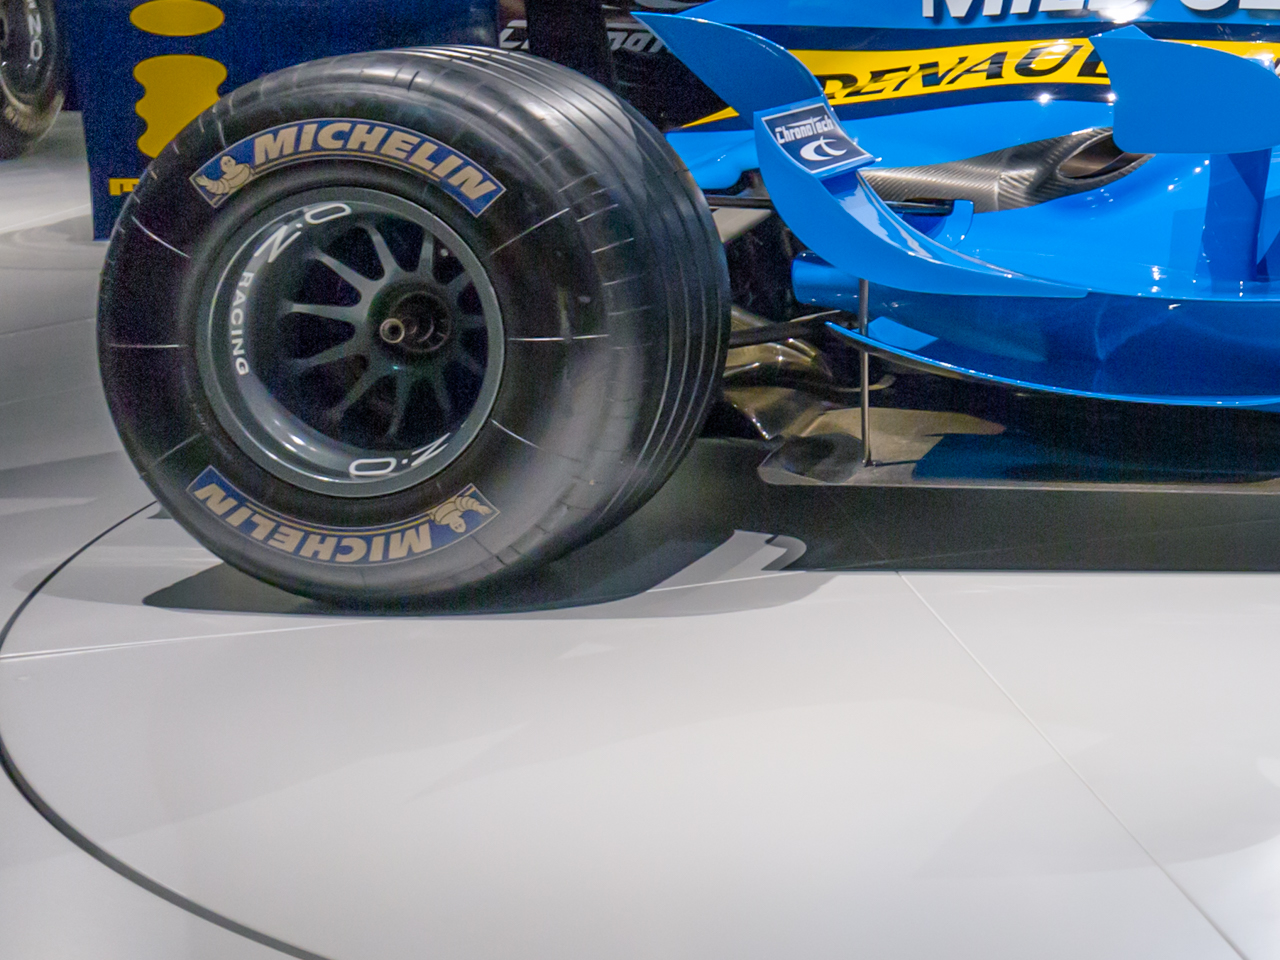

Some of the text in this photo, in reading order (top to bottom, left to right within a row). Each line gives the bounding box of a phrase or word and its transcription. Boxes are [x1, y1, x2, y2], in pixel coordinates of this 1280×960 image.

[815, 45, 1109, 98] RENAUL
[254, 121, 501, 201] MICHELIN
[230, 271, 256, 375] RACING
[196, 481, 432, 563] MICHELIN
